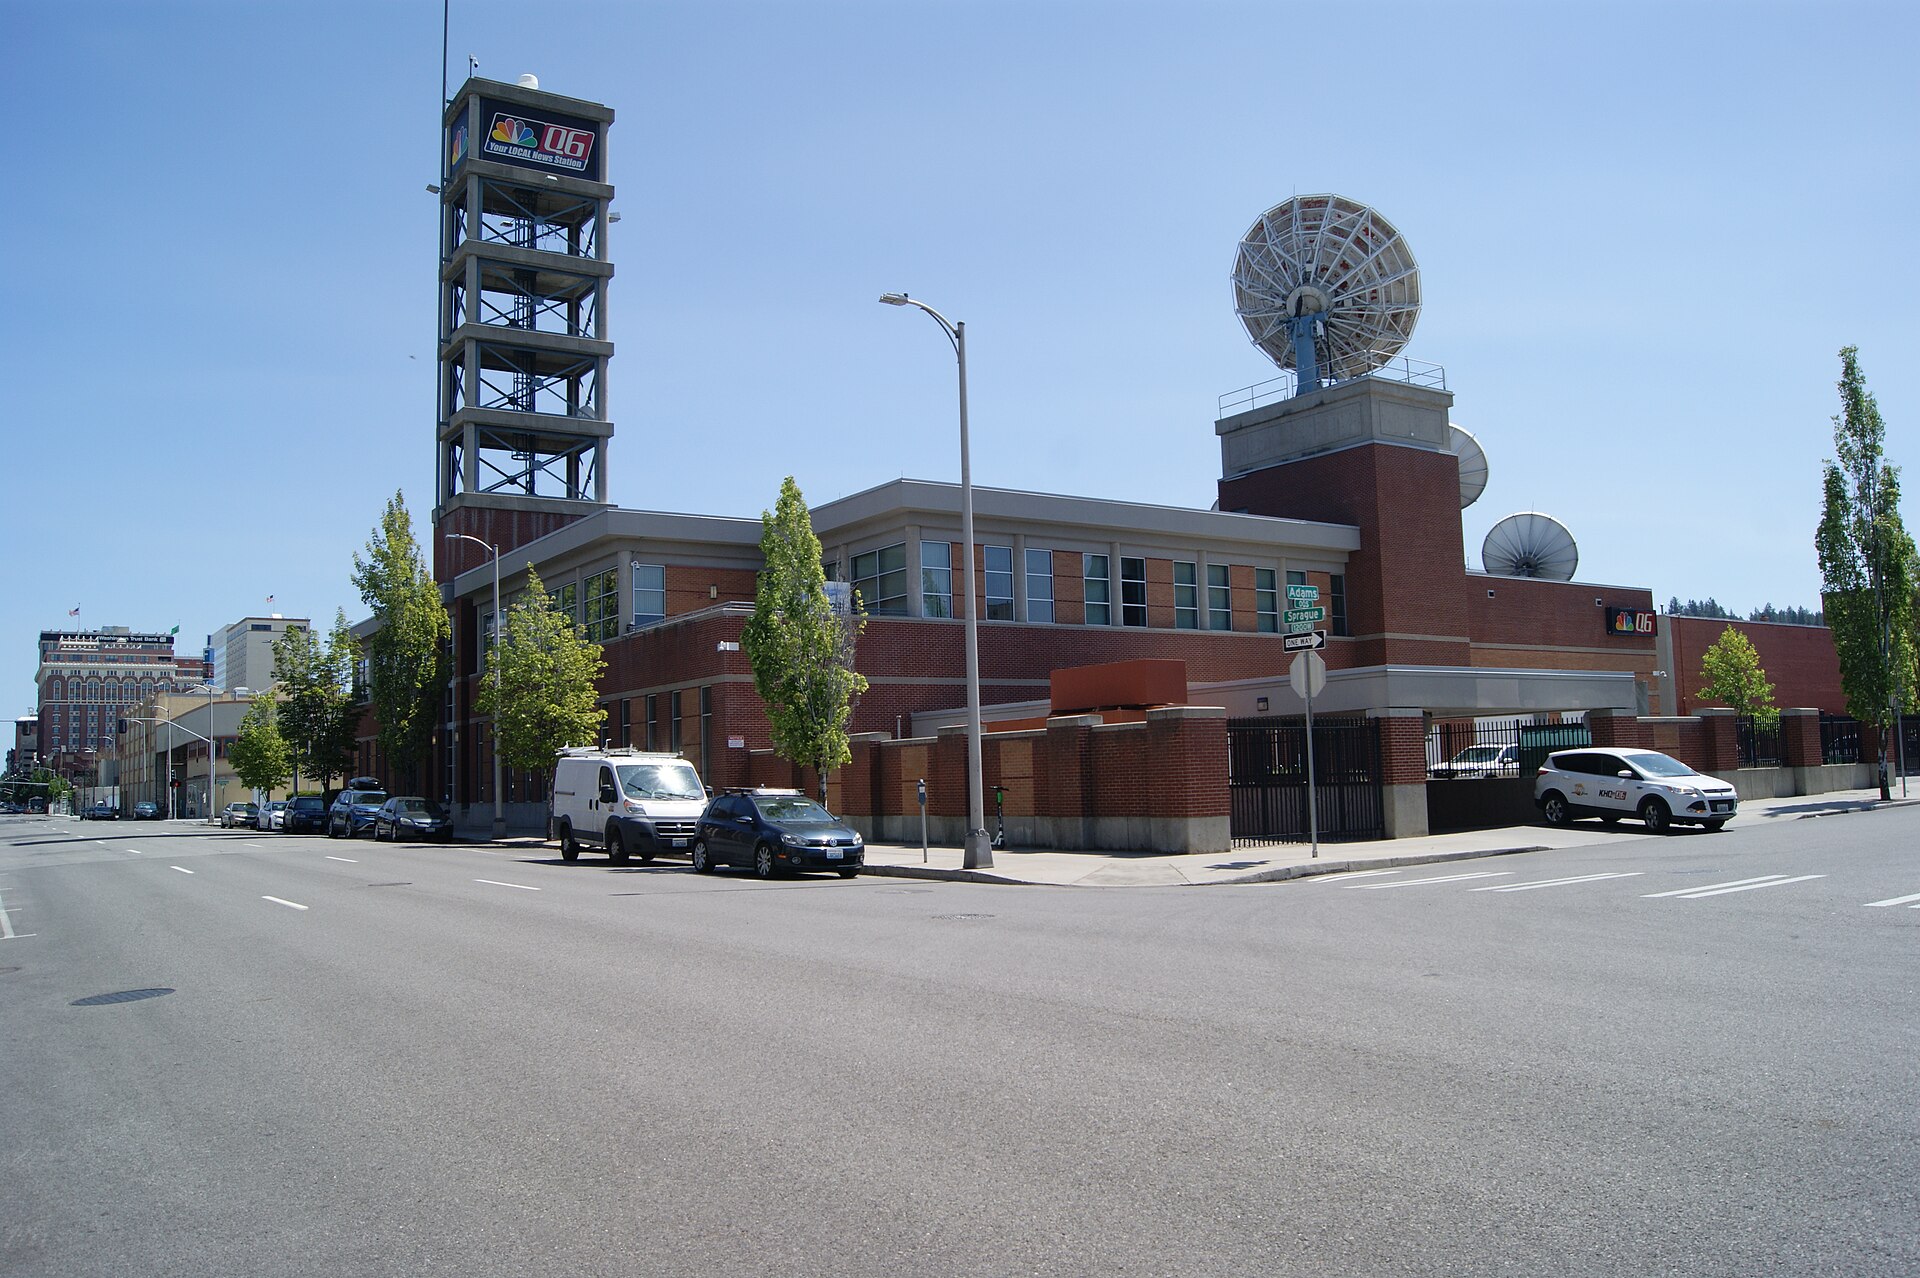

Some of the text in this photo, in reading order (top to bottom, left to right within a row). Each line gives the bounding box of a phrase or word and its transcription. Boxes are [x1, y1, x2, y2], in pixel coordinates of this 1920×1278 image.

[543, 126, 589, 157] Q6
[489, 142, 582, 168] Your LOCAL News Station
[1289, 587, 1317, 598] Adams
[1287, 610, 1319, 622] Sprague
[1635, 613, 1653, 632] Q6
[1286, 637, 1312, 647] ONE WAY
